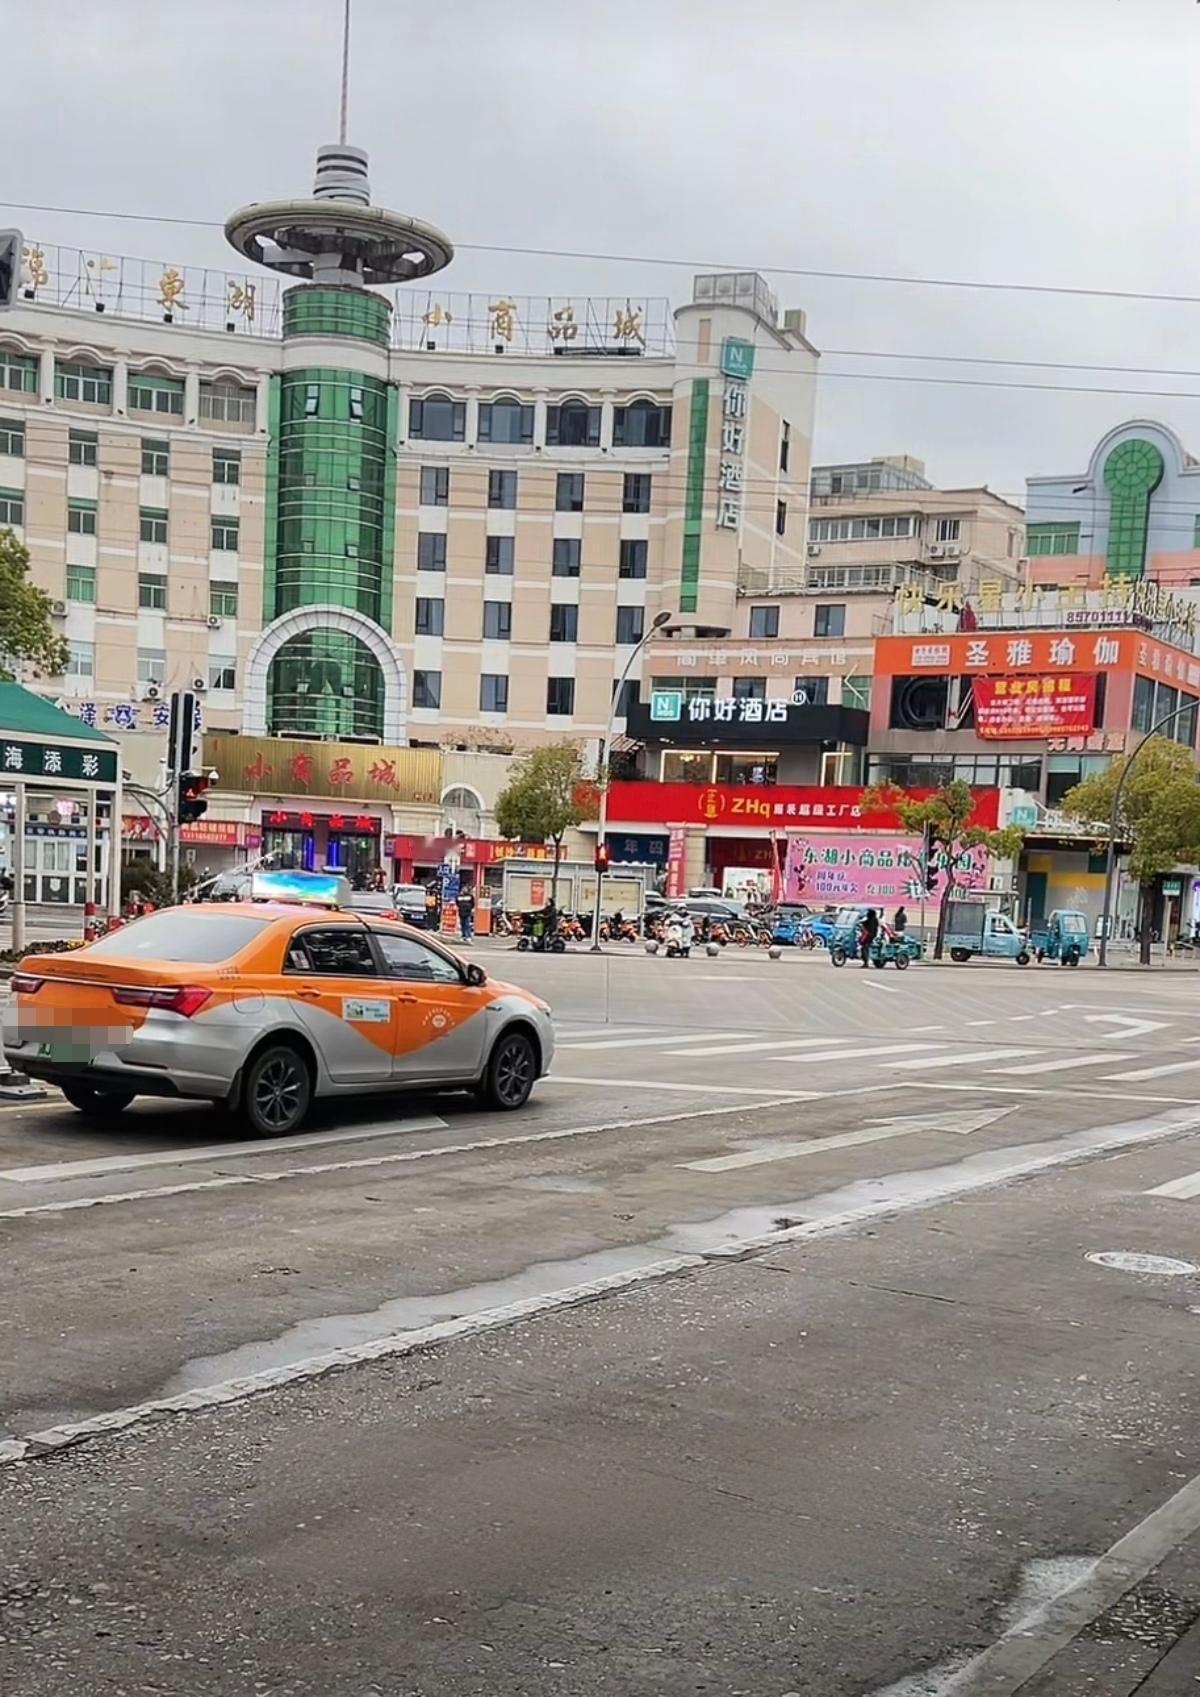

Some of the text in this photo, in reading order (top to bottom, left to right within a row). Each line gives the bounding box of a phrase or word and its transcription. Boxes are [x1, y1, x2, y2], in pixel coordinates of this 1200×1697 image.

[421, 299, 645, 347] 小商品城
[717, 384, 747, 530] 你好酒店
[966, 636, 1119, 667] 圣雅瑜伽
[688, 697, 788, 722] 你好酒店
[244, 752, 401, 792] 小商品城
[731, 798, 770, 818] ZHq
